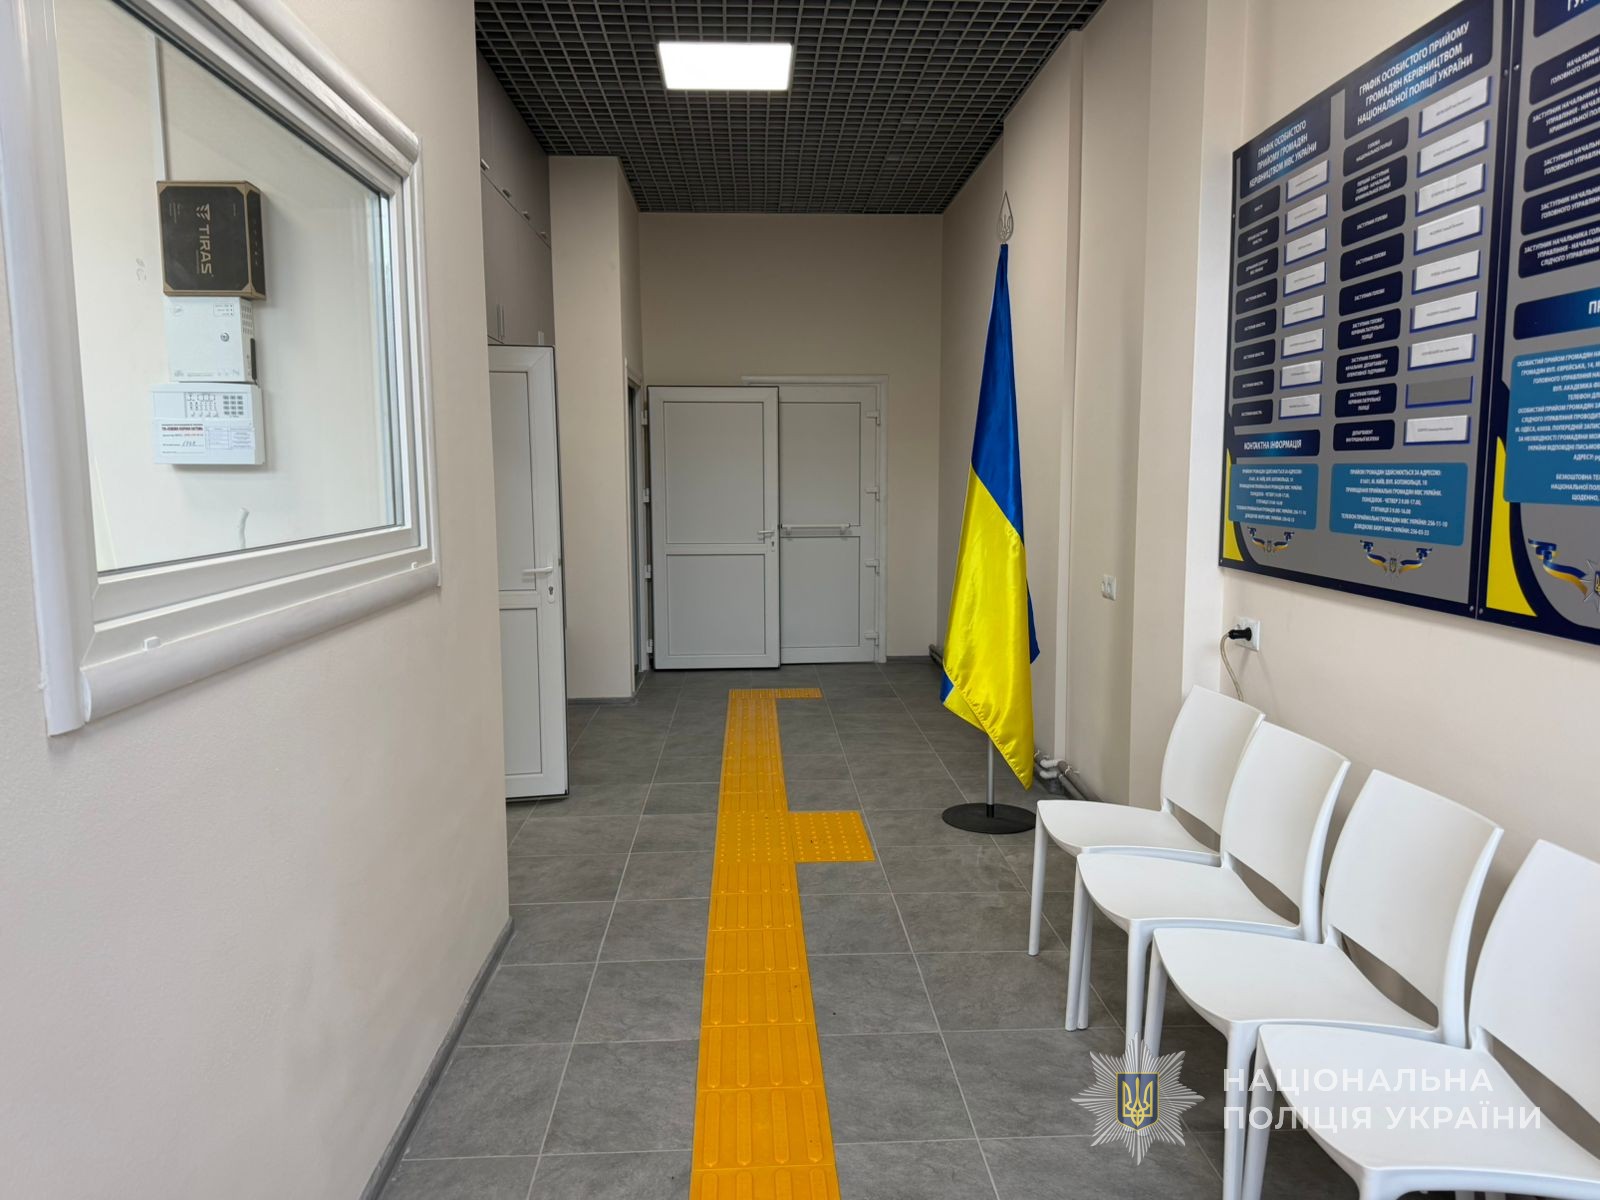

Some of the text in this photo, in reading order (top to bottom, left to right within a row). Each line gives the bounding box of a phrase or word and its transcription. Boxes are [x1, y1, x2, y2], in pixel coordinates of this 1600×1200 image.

[1359, 21, 1469, 96] ГРАФІК ОСОБИСТОГО ПРИЙОМУ
[1566, 46, 1600, 69] НАЧАЛЬНИК
[1365, 77, 1403, 107] ГРОМАДЯН
[1403, 43, 1463, 85] КЕРІВНИЦТВОМ
[1550, 65, 1580, 85] ГОЛОВНОГО
[1357, 86, 1408, 126] НАЦІОНАЛЬНОЇ
[1409, 71, 1437, 98] ПОЛІЦІЇ
[1438, 53, 1473, 81] УКРАЇНИ
[1532, 104, 1561, 123] ЗАСТУПНИК
[1274, 120, 1306, 147] ОСОБИСТОГО
[1543, 150, 1573, 167] ЗАСТУПНИК
[1544, 159, 1574, 176] ГОЛОВНОГО
[1541, 196, 1570, 211] ЗАСТУПНИК
[1541, 205, 1571, 220] ГОЛОВНОГО
[199, 224, 212, 274] TIRAS
[1524, 240, 1552, 254] ЗАСТУПНИК
[1553, 230, 1588, 245] НАЧАЛЬНИКА
[1537, 244, 1568, 259] УПРАВЛІННЯ
[1566, 246, 1600, 260] УПРАВЛІННЯ
[1270, 439, 1302, 450] ІНФОРМАЦІЯ
